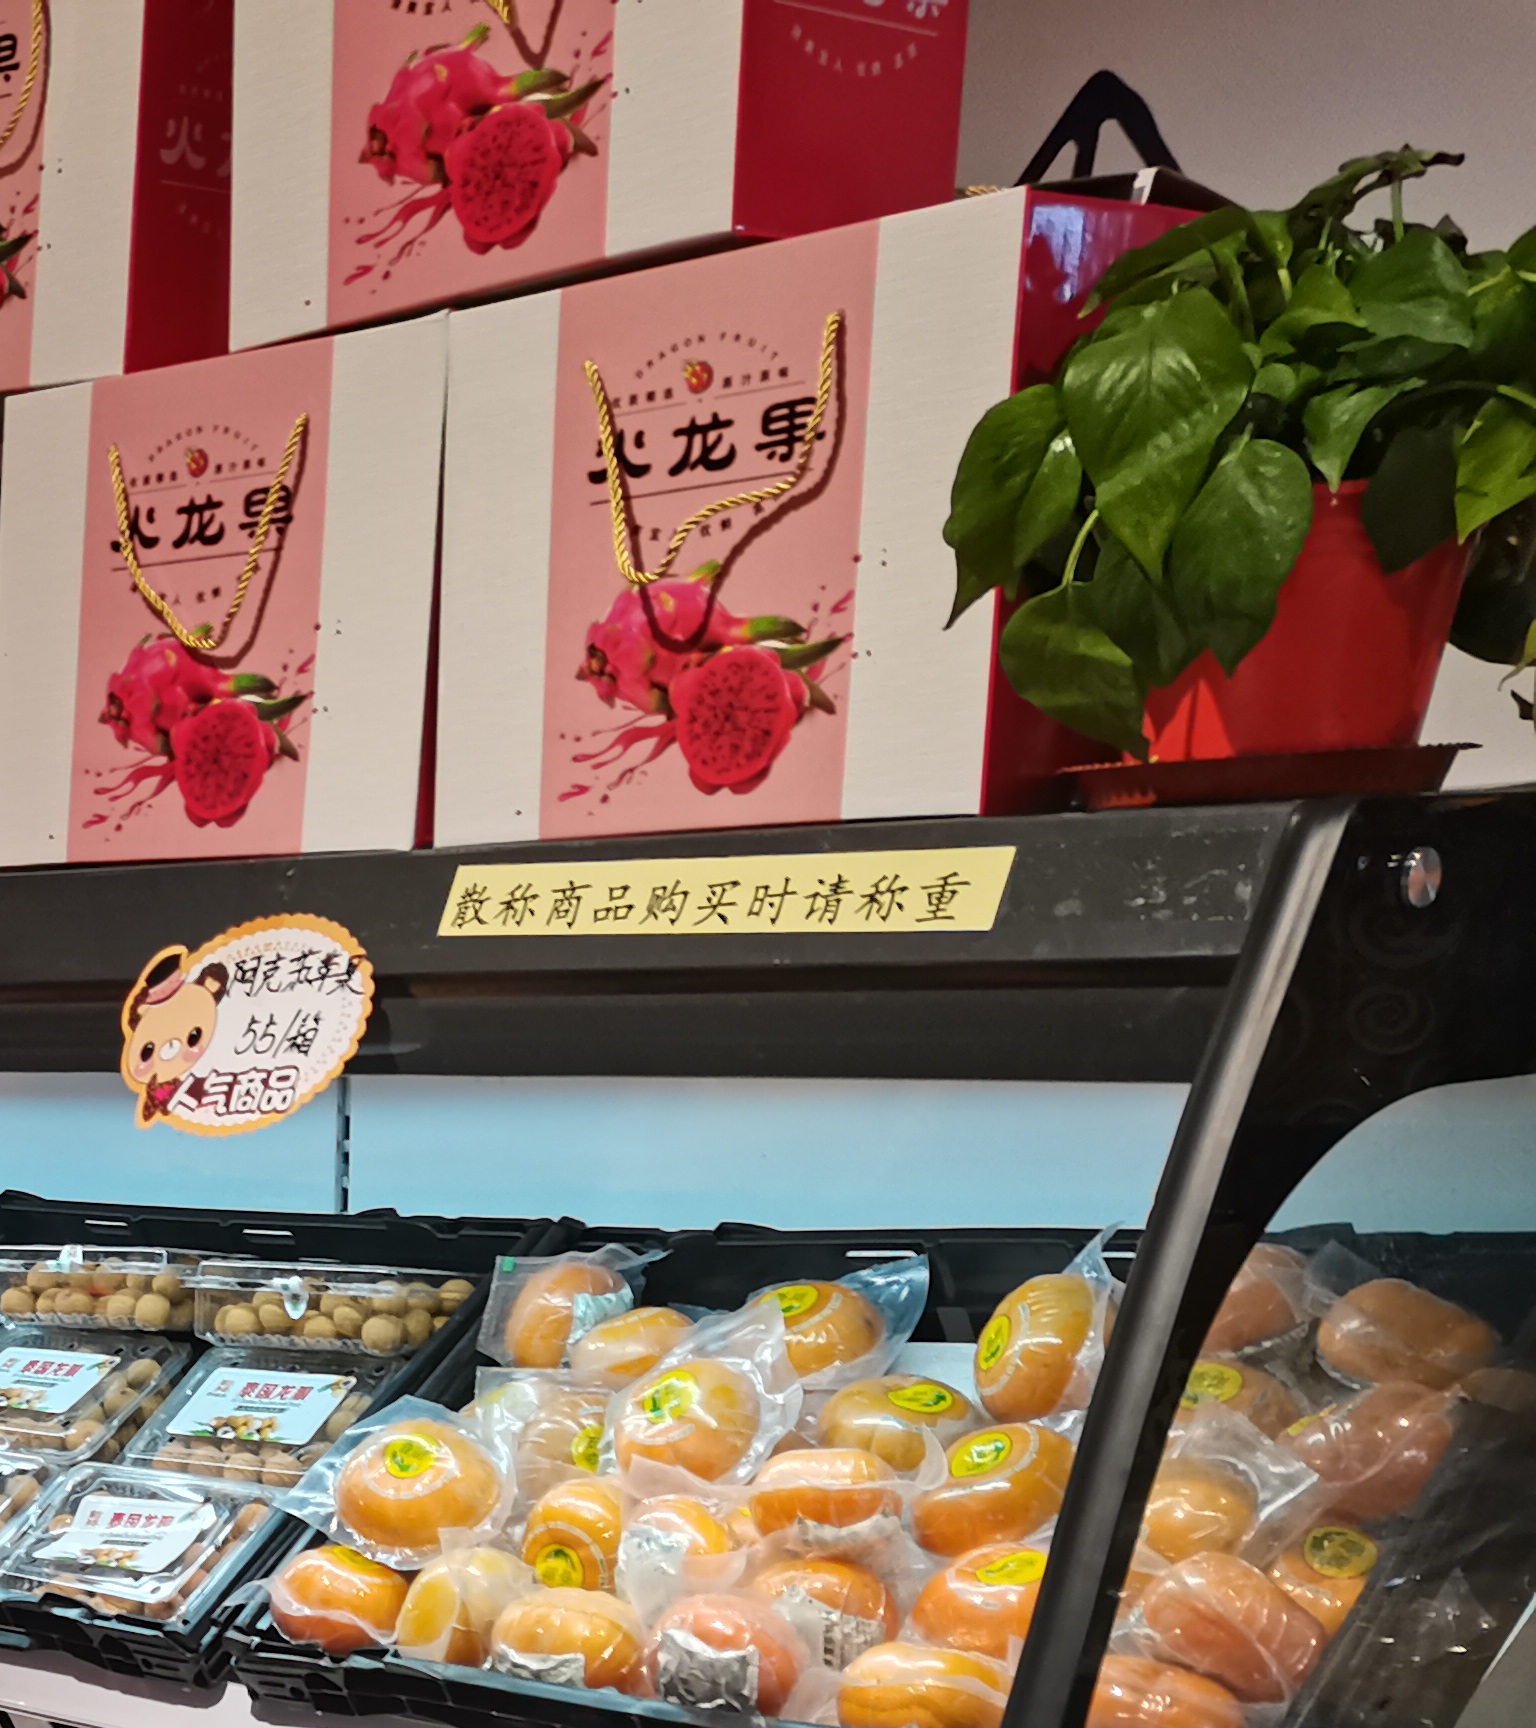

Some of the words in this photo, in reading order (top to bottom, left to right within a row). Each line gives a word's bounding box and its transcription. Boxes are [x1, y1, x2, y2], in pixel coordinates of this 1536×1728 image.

[587, 396, 826, 484] 火龙果
[110, 484, 293, 549] 火龙果
[451, 872, 970, 929] 散称商品购买时请称重
[168, 1066, 300, 1117] 人气商品
